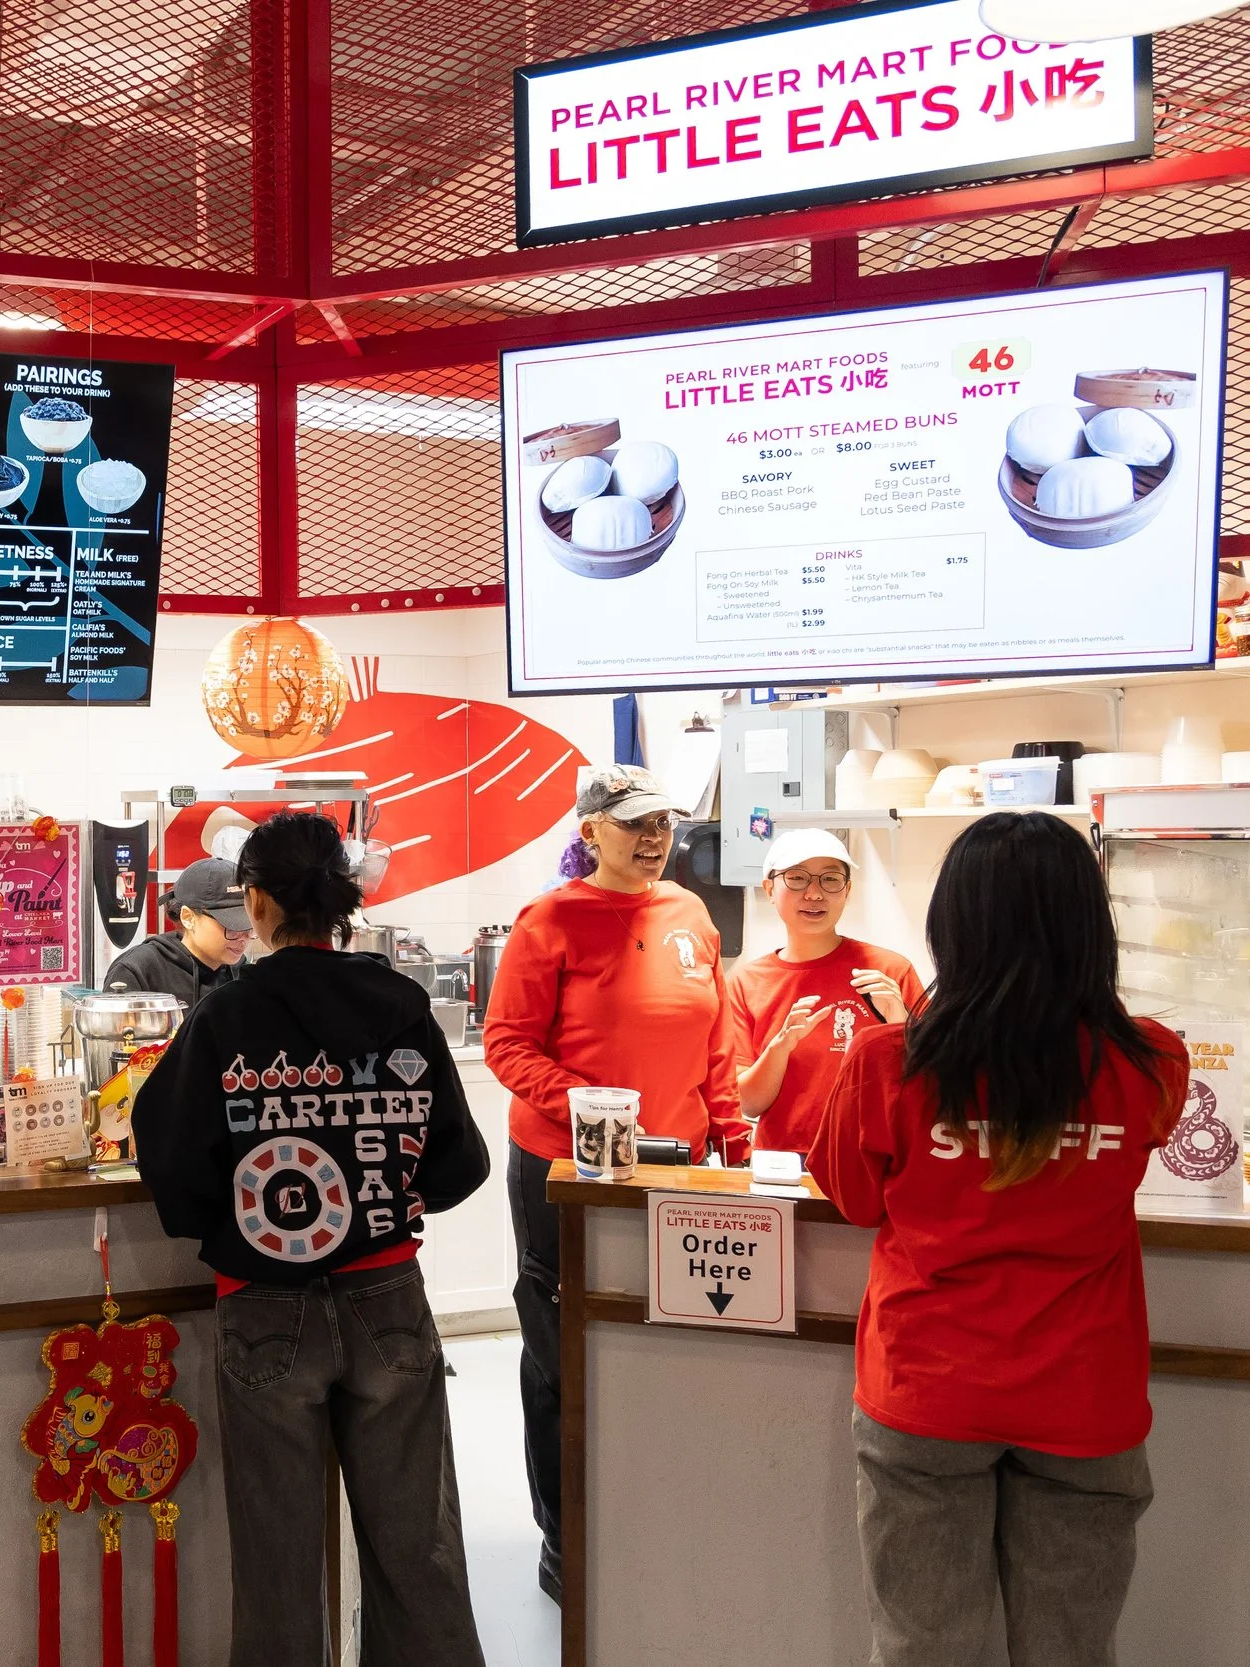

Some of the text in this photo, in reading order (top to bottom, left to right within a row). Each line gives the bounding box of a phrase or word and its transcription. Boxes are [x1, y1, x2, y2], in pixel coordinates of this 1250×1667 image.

[550, 34, 1069, 132] PEARL RIVER MART FOO
[549, 58, 1104, 190] LITTLE EATS 小吃
[901, 359, 940, 371] featuring
[968, 346, 1014, 372] 46
[16, 364, 102, 386] PAIRINGS
[665, 352, 888, 385] PEARL RIVER MART FOODS
[4, 383, 110, 398] (ADD THESE TO YOUR DRINK)
[665, 368, 888, 410] LITTLE EATS 小吃
[962, 381, 1021, 399] MOTT
[726, 412, 958, 445] 46 MOTT STEAMED BUNS
[759, 441, 872, 460] $3.00 OR $8.00
[890, 459, 936, 472] SWEET
[742, 471, 793, 484] SAVORY
[721, 484, 814, 501] BBQ Roast Pork
[718, 499, 817, 516] Chinese Sausage
[77, 548, 139, 563] MILK (FREE)
[815, 550, 863, 561] DRINKS
[802, 565, 825, 574] $5.50
[802, 576, 825, 584] $5.50
[802, 608, 823, 616] $1.99
[802, 619, 825, 627] $2.99
[17, 881, 33, 889] and
[8, 890, 63, 912] Paint
[14, 913, 23, 921] at
[1190, 1042, 1235, 1056] YEAR
[225, 1090, 433, 1133] CARTIER
[929, 1120, 1125, 1160] STFF
[667, 1209, 772, 1221] PEARL RIVER MART FOODS
[666, 1216, 772, 1233] LITTLE EATS 小吃
[682, 1233, 758, 1257] Order
[689, 1258, 752, 1281] Here
